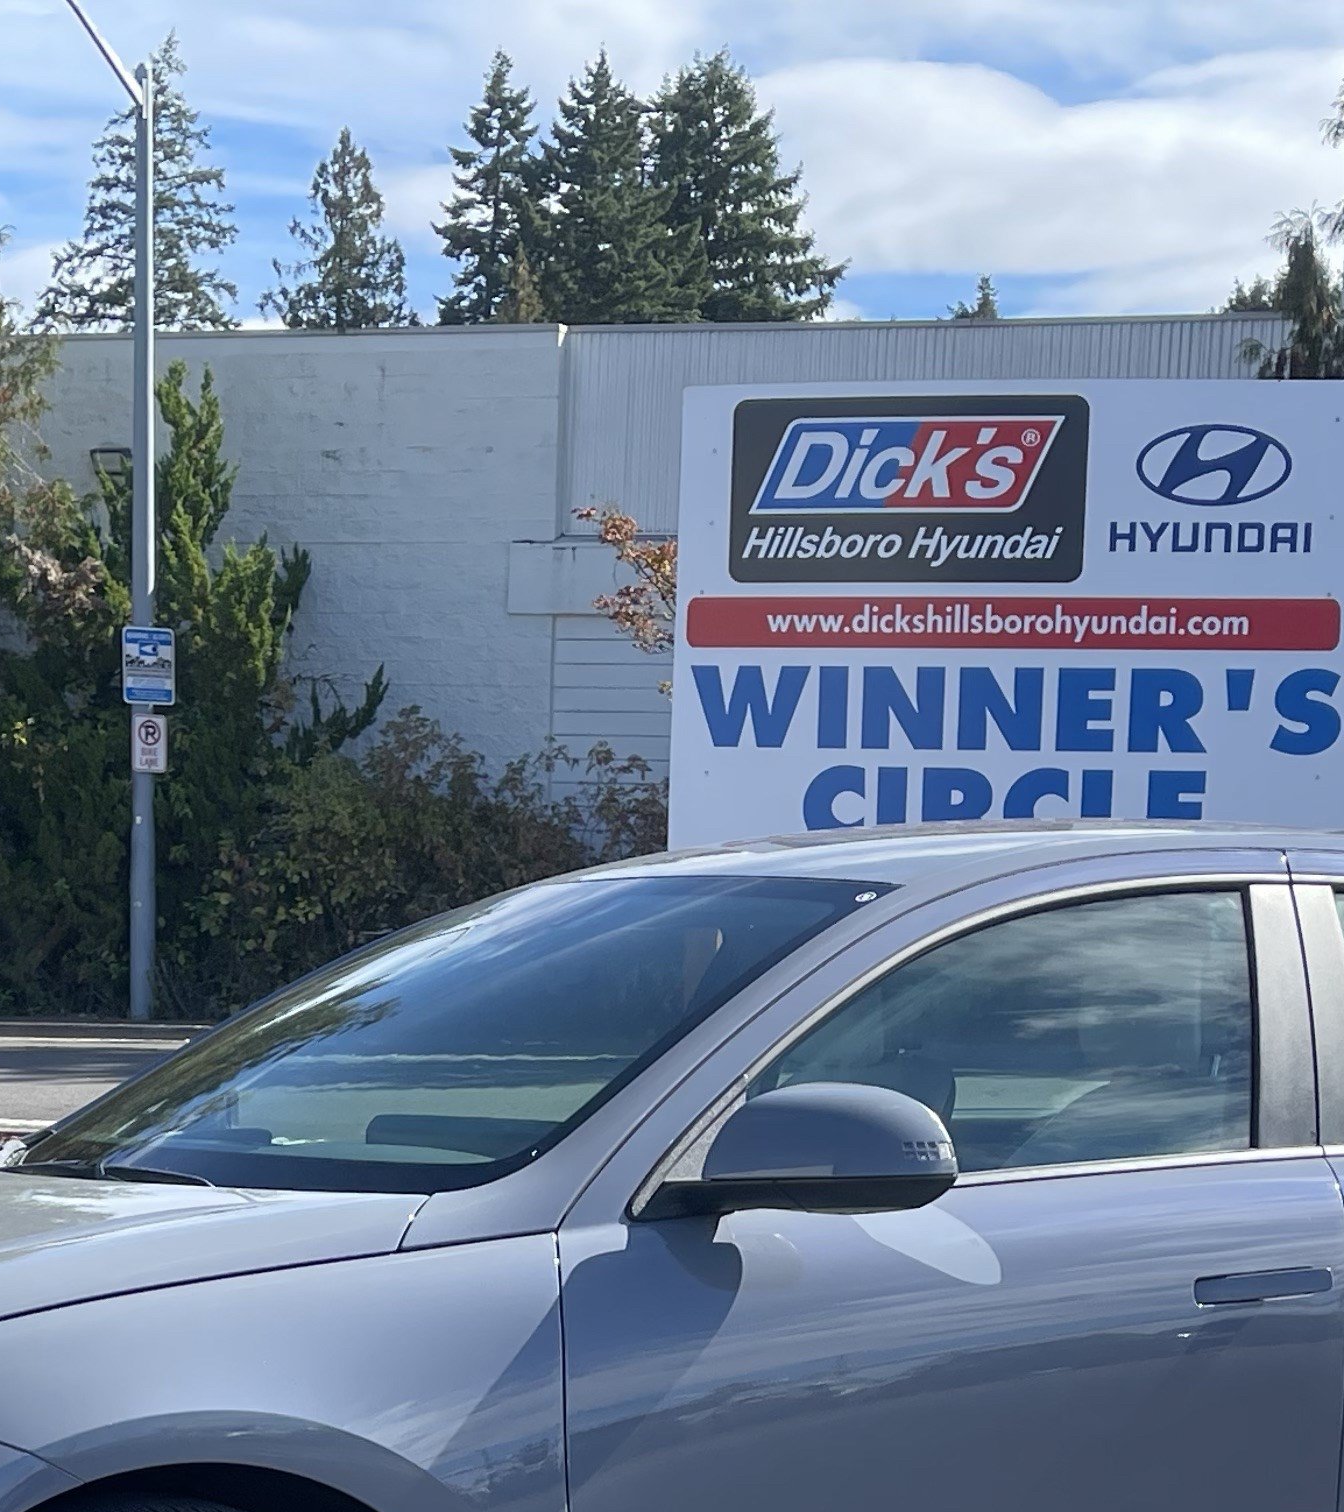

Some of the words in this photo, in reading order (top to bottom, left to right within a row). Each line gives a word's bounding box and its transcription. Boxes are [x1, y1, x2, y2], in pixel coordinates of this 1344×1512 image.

[773, 427, 1023, 500] Dick's
[742, 526, 903, 559] Hillsboro
[908, 526, 1064, 567] Hyundai
[1109, 521, 1312, 553] HYUNDAI
[766, 604, 1250, 643] www.dickshillsborohyundai.com
[692, 666, 1342, 756] WINNER'S
